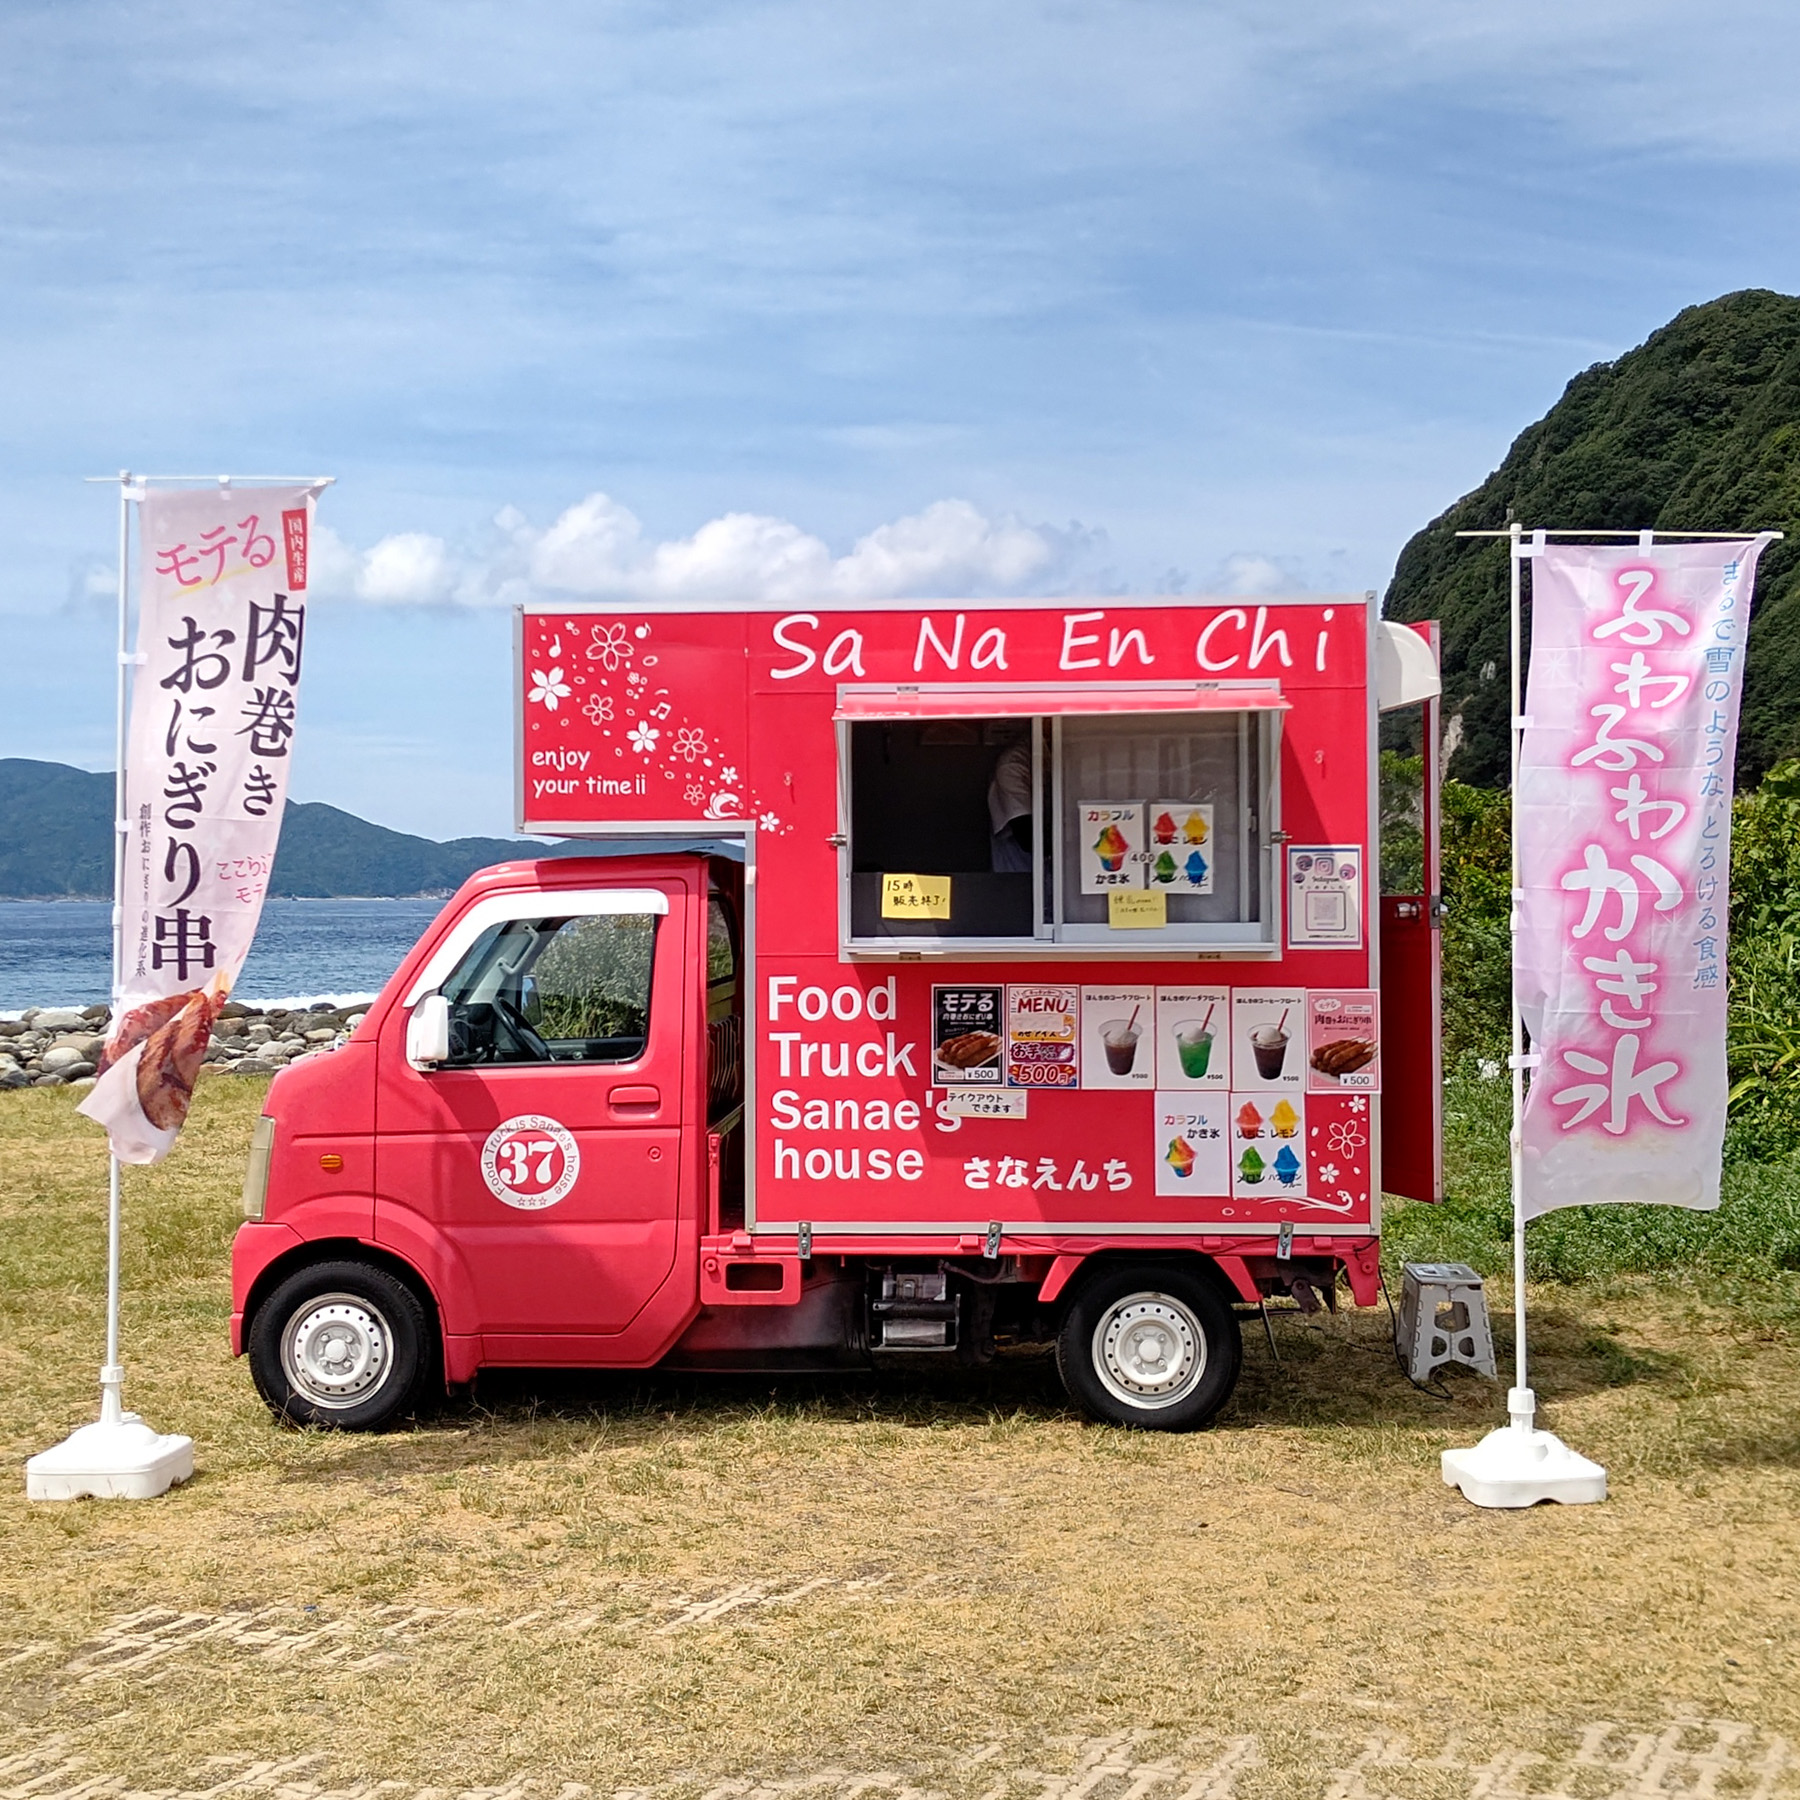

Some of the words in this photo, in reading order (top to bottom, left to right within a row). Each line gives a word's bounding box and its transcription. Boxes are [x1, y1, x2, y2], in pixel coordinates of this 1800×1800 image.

[155, 514, 277, 587] モテる
[769, 613, 866, 680] Sa
[913, 613, 1009, 672] Na
[1059, 610, 1155, 671] En
[1196, 605, 1335, 672] Chi
[234, 593, 305, 817] 肉巻き
[532, 745, 591, 772] enjoy
[152, 616, 237, 982] おにぎり串
[532, 778, 580, 799] your
[1087, 809, 1135, 821] カラフル
[1551, 570, 1691, 1134] ふわふわかき氷
[887, 879, 914, 893] 15時
[1095, 873, 1130, 885] かき氷
[768, 975, 897, 1022] Food
[942, 993, 994, 1012] モテる
[1017, 998, 1069, 1014] MENU
[768, 1032, 918, 1078] Truck
[948, 1092, 1004, 1103] テイクアウト
[971, 1103, 1012, 1114] できます
[515, 1119, 526, 1130] is
[529, 1116, 573, 1151] Sanae's
[1164, 1114, 1208, 1126] カラフル
[1186, 1128, 1221, 1140] かき氷
[1270, 1128, 1300, 1139] レモン
[484, 1124, 514, 1155] Truck
[499, 1140, 558, 1186] 37
[554, 1155, 577, 1195] house
[774, 1138, 924, 1181] house
[963, 1155, 1133, 1192] さなえんち
[484, 1161, 506, 1196] Food
